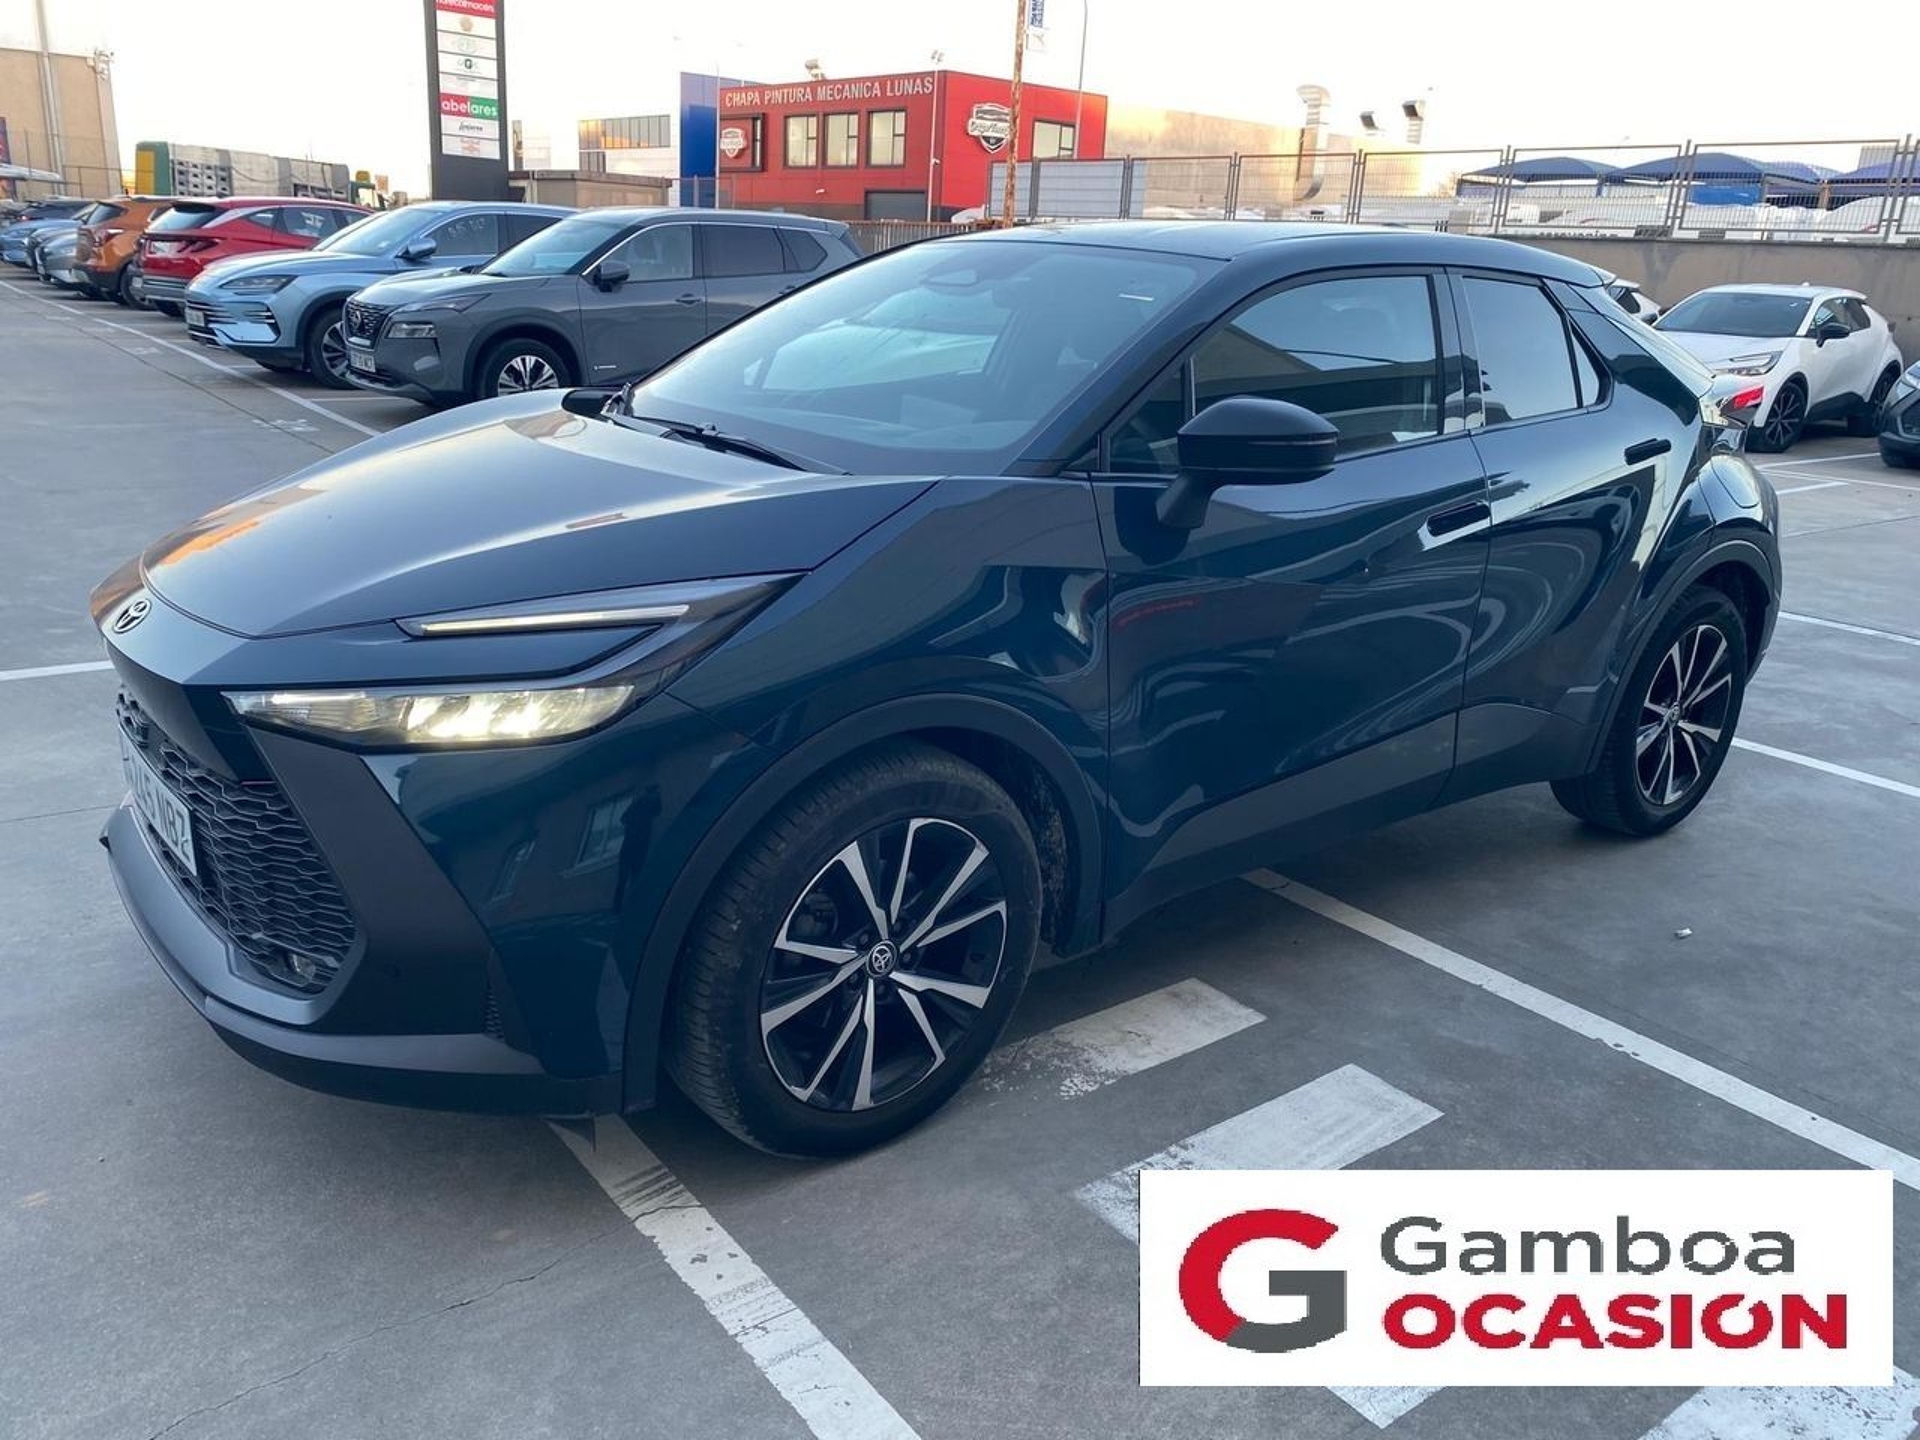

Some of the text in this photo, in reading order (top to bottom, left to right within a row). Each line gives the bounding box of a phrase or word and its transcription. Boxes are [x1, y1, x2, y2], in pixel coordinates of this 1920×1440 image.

[725, 77, 934, 108] CHAPA PINTURA MECANICA LUNAS
[441, 100, 498, 116] abelares
